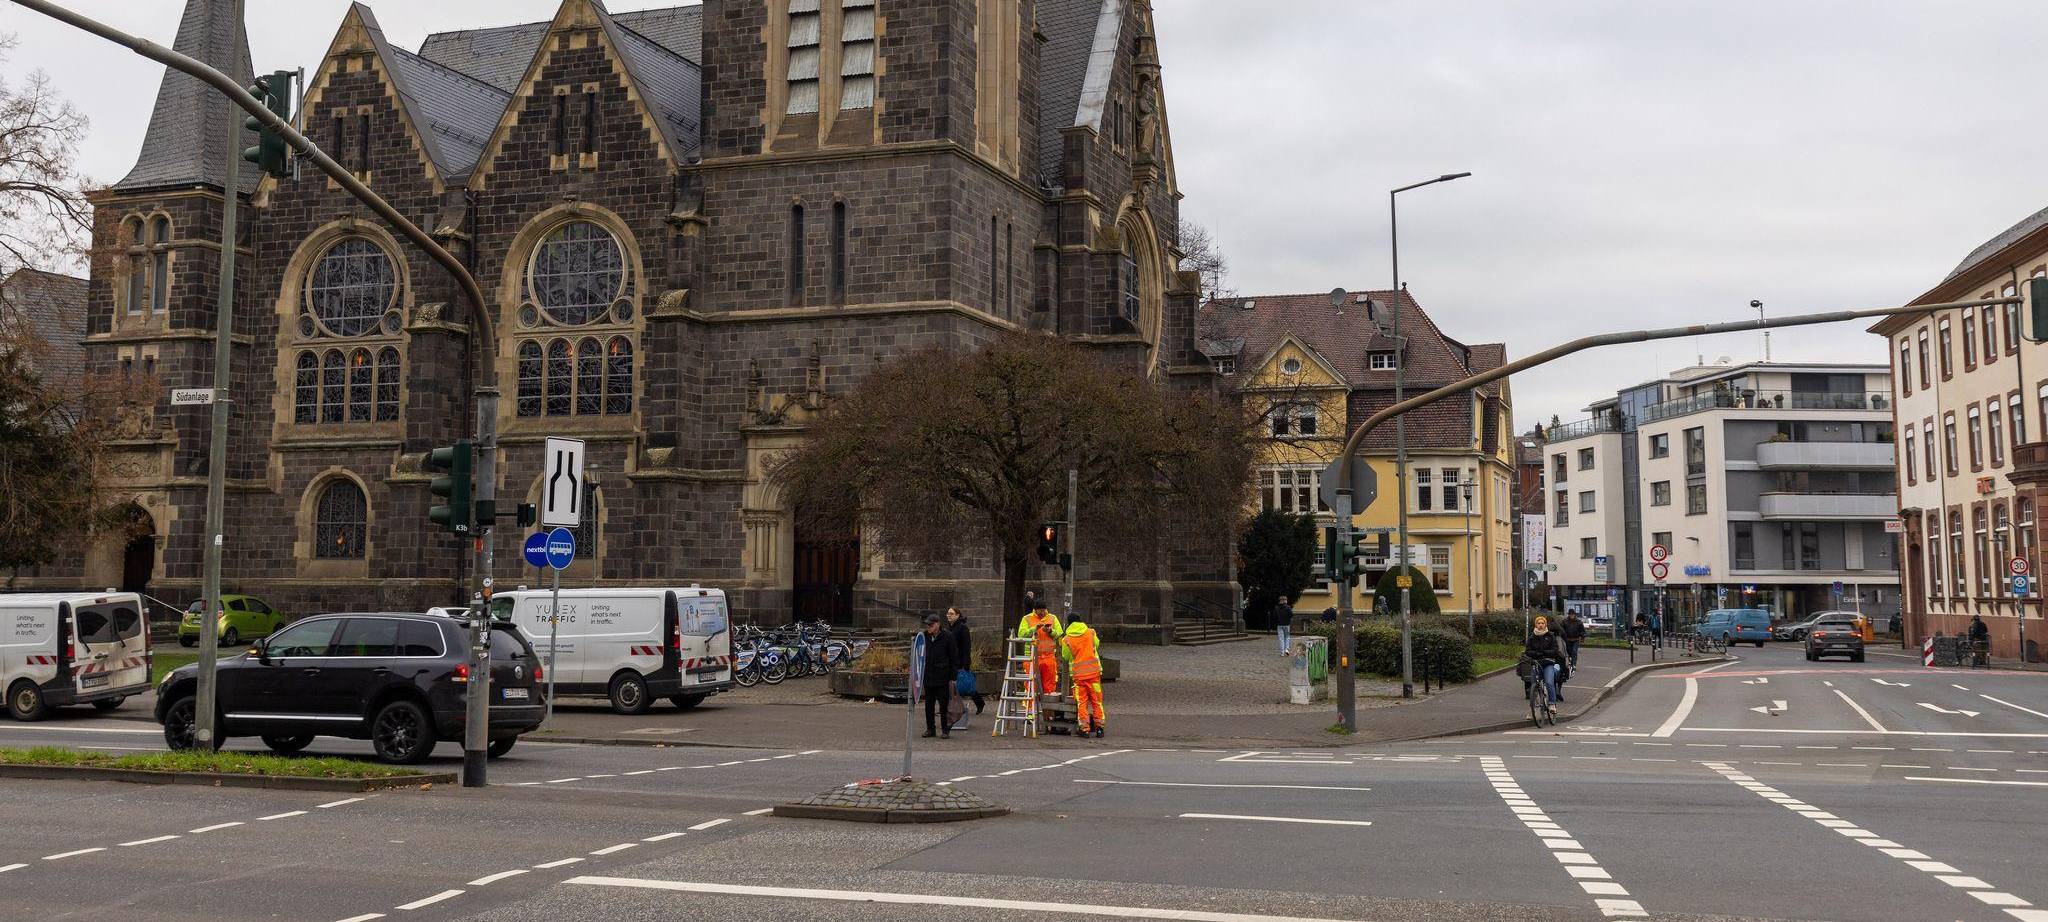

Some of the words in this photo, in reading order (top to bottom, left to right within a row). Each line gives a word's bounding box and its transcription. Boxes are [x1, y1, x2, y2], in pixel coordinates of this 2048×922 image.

[175, 392, 209, 403] Südanlage
[455, 524, 468, 532] K3b
[1654, 550, 1664, 558] 30
[2013, 561, 2025, 570] 30
